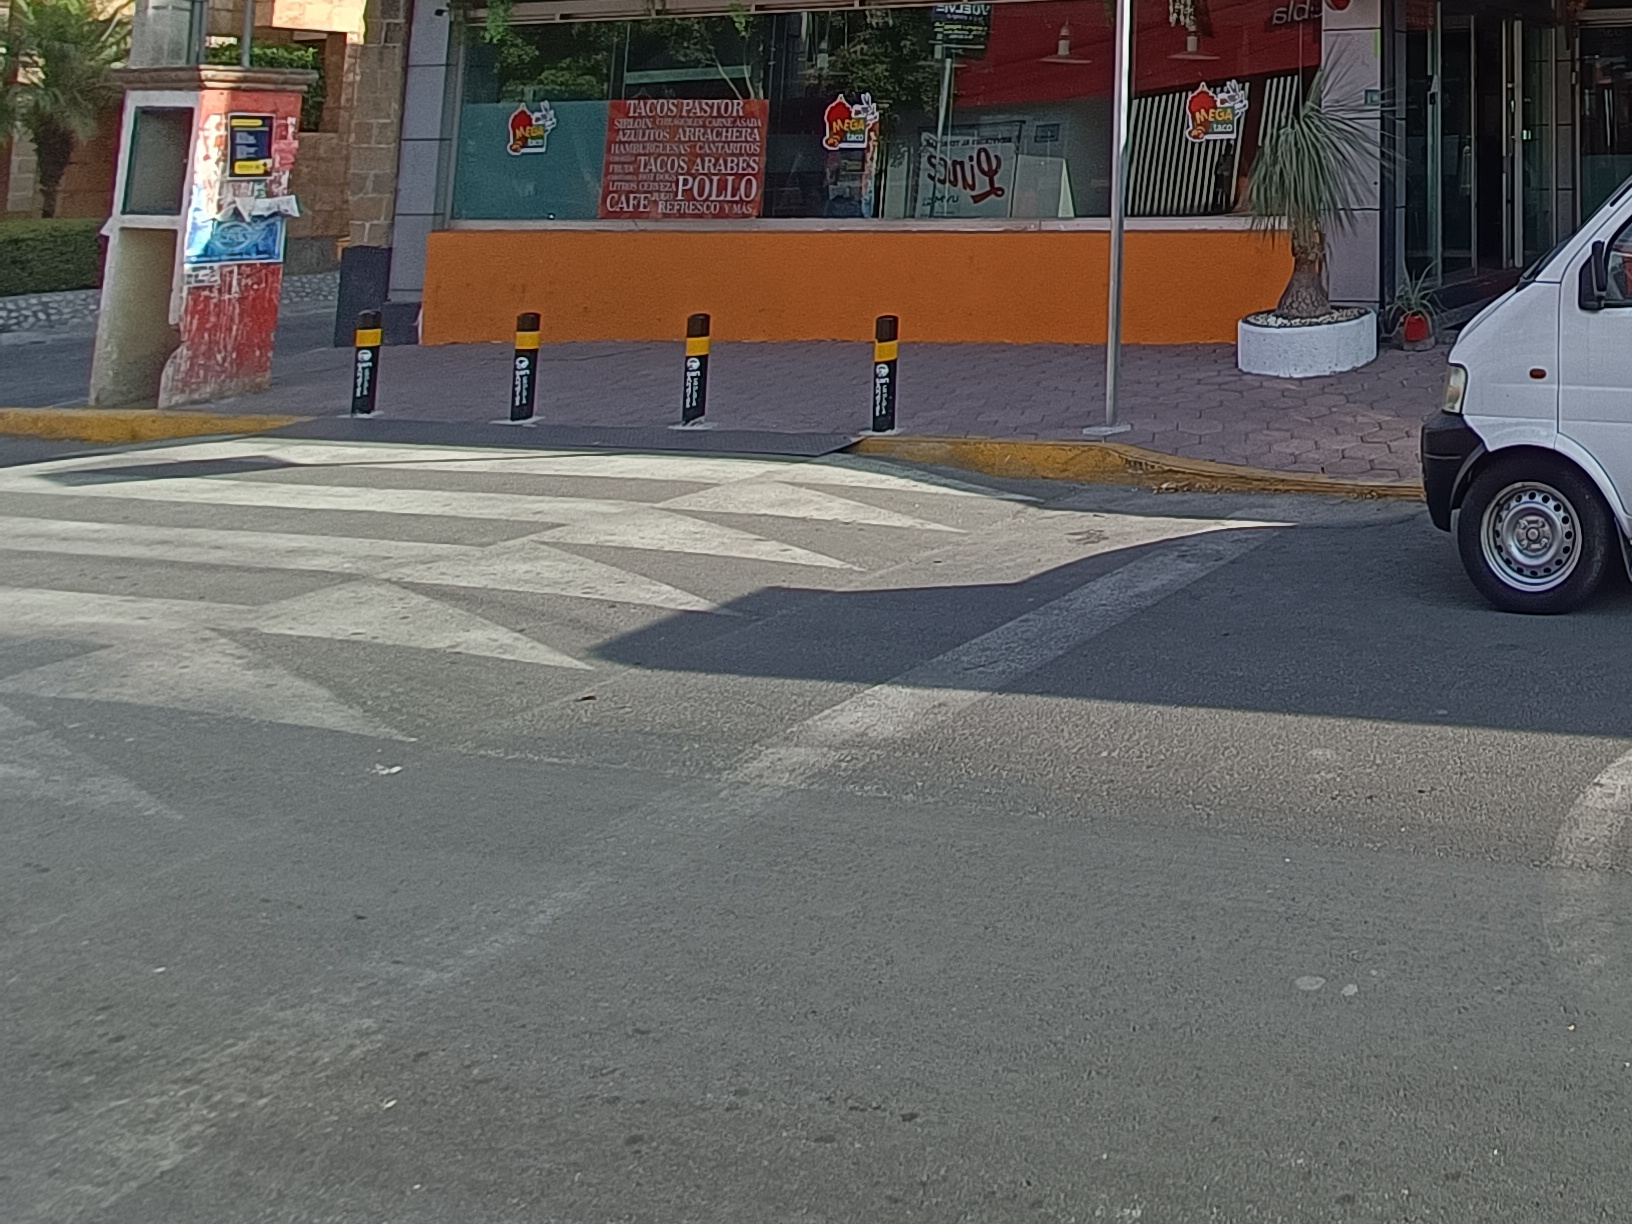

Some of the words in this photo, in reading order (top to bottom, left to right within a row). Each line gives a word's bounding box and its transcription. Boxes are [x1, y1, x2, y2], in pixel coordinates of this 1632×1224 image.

[626, 99, 678, 117] TACOS
[680, 99, 744, 117] PASTOR
[1195, 108, 1233, 124] MEGA
[832, 118, 864, 134] MEGA
[616, 129, 669, 142] AZULITOS
[675, 128, 760, 141] ARRACHERA
[611, 142, 691, 155] HAMBURGUESAS
[695, 142, 761, 155] CANTARITOS
[637, 155, 688, 174] TACOS
[675, 175, 758, 202] POLLO
[606, 193, 651, 212] CAFE
[658, 201, 720, 214] REFRESCO
